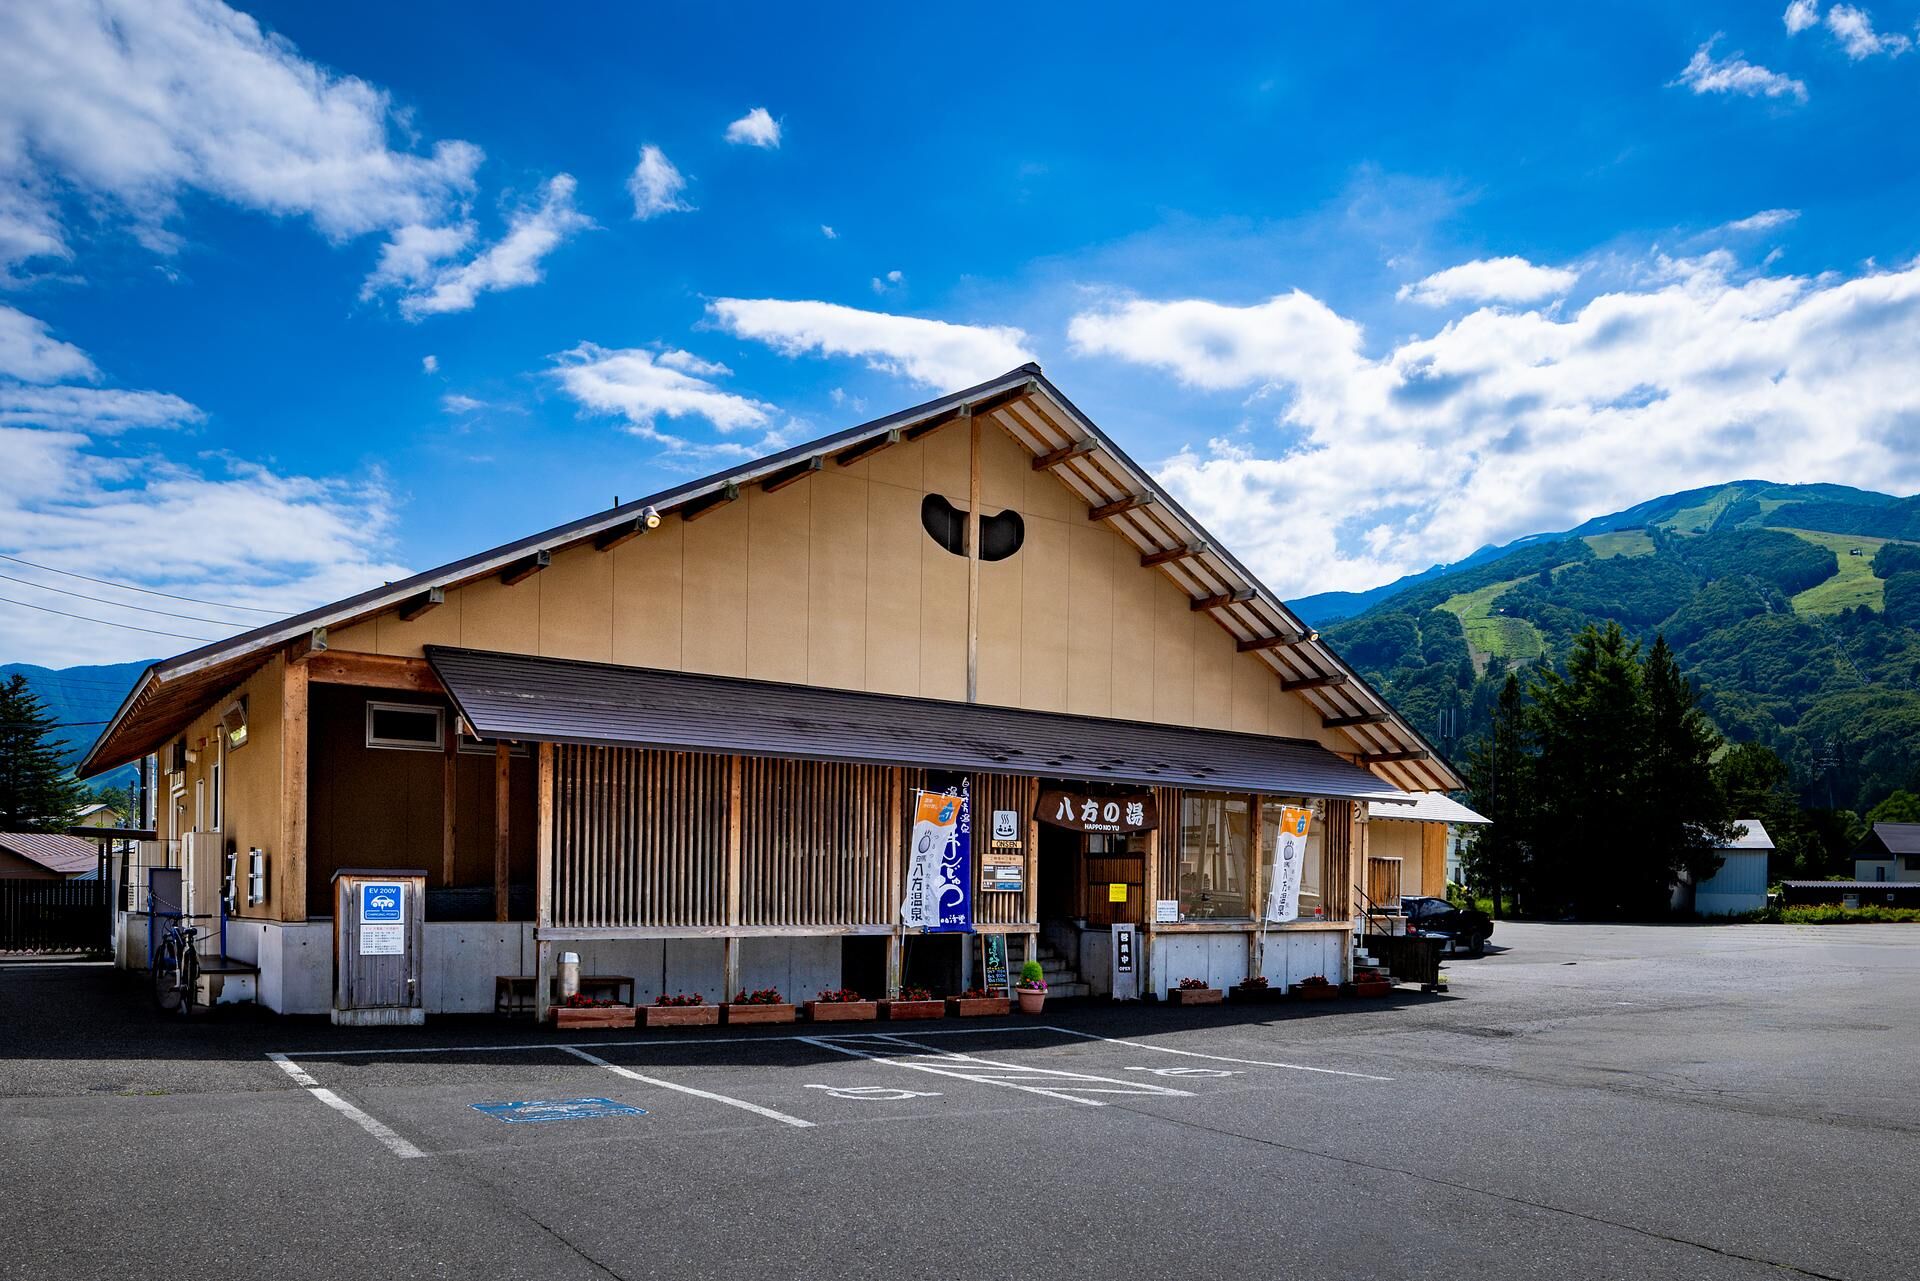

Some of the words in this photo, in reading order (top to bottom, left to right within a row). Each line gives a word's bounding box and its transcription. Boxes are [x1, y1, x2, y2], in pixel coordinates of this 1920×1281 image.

[1056, 796, 1144, 826] 八方の湯
[911, 863, 924, 921] 八方温泉
[1120, 933, 1129, 964] 営業中
